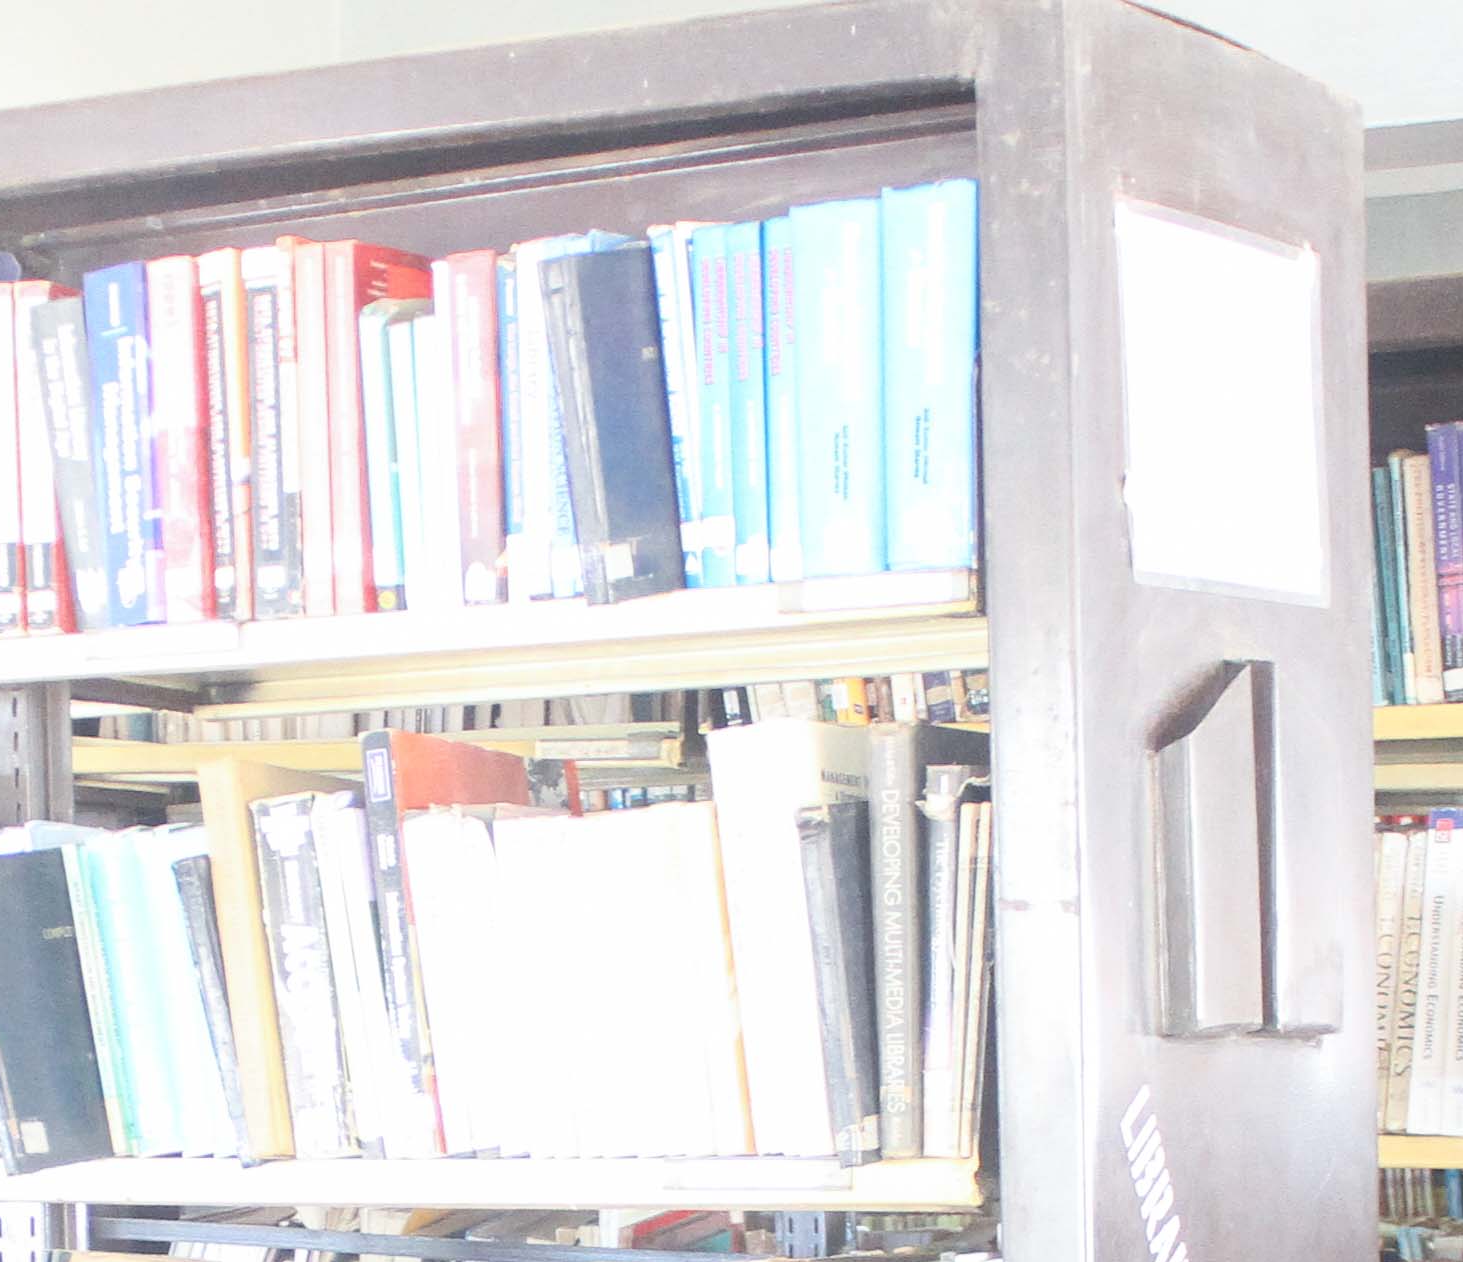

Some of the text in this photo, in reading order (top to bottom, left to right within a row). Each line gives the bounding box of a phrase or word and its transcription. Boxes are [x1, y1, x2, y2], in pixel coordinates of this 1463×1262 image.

[1435, 484, 1448, 563] GOVERNMENT
[1446, 483, 1462, 560] STATE AND LOCAL
[879, 789, 910, 1112] DEVELOPING MULTI-MEDIA LIBRARIES
[1394, 915, 1420, 1078] ECONOMICS
[1422, 895, 1445, 1061] UNDERSTANDING ECONOMICS
